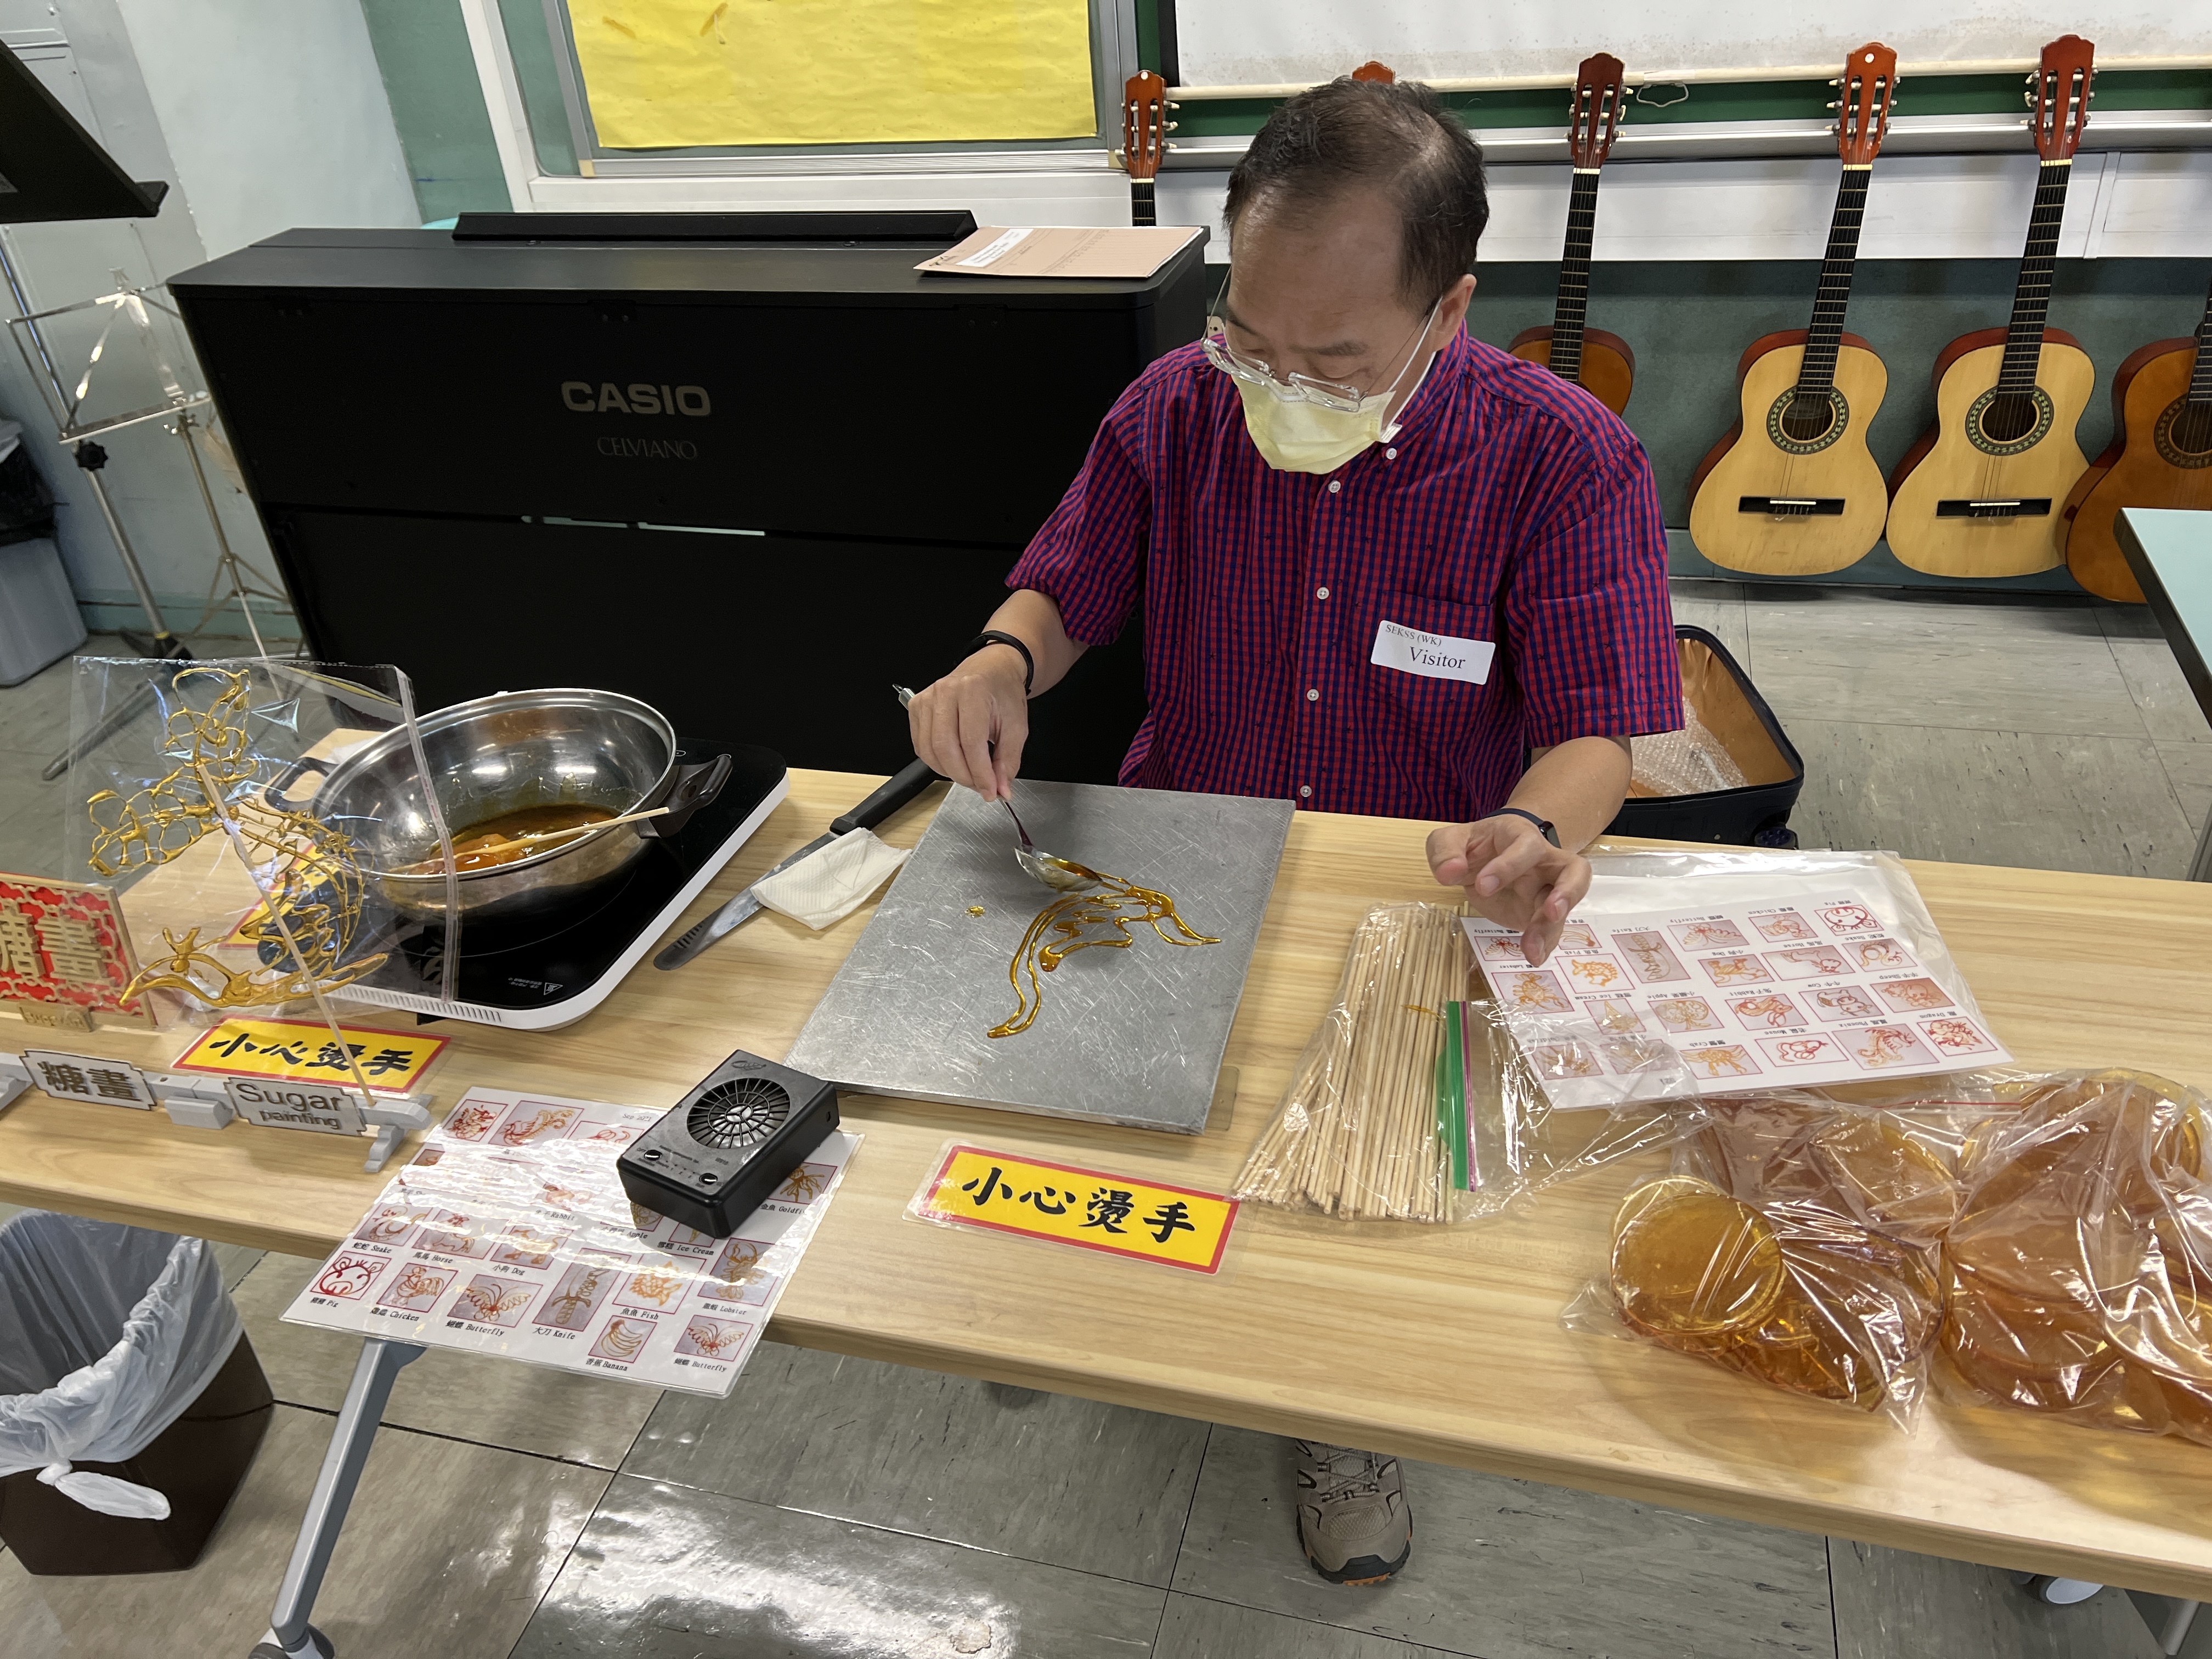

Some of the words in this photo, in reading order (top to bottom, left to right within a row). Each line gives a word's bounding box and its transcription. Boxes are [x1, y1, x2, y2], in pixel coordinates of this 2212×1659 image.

[561, 381, 712, 416] CASIO
[597, 437, 697, 459] CELVIANO
[1385, 624, 1415, 640] SEKSS
[1417, 634, 1442, 647] (WK)
[1410, 646, 1466, 669] Visitor
[208, 1033, 415, 1076] 小心燙手
[37, 1061, 143, 1102] 糖畫
[236, 1083, 341, 1111] Sugar
[259, 1110, 342, 1130] painting
[962, 1166, 1195, 1244] 小心燙手
[551, 1212, 575, 1221] Rabbit
[627, 1231, 648, 1239] Apple
[371, 1245, 392, 1254] Snake
[692, 1246, 714, 1255] Cream
[432, 1255, 453, 1263] Horse
[511, 1267, 526, 1276] Dog
[641, 1311, 659, 1320] Fish
[720, 1305, 747, 1315] Lobster
[390, 1311, 420, 1322] Chicken
[465, 1324, 505, 1336] Butterfly
[532, 1327, 552, 1336] 大刀
[553, 1329, 575, 1340] Knife
[602, 1361, 628, 1372] Banana
[691, 1361, 727, 1372] Butterfly
